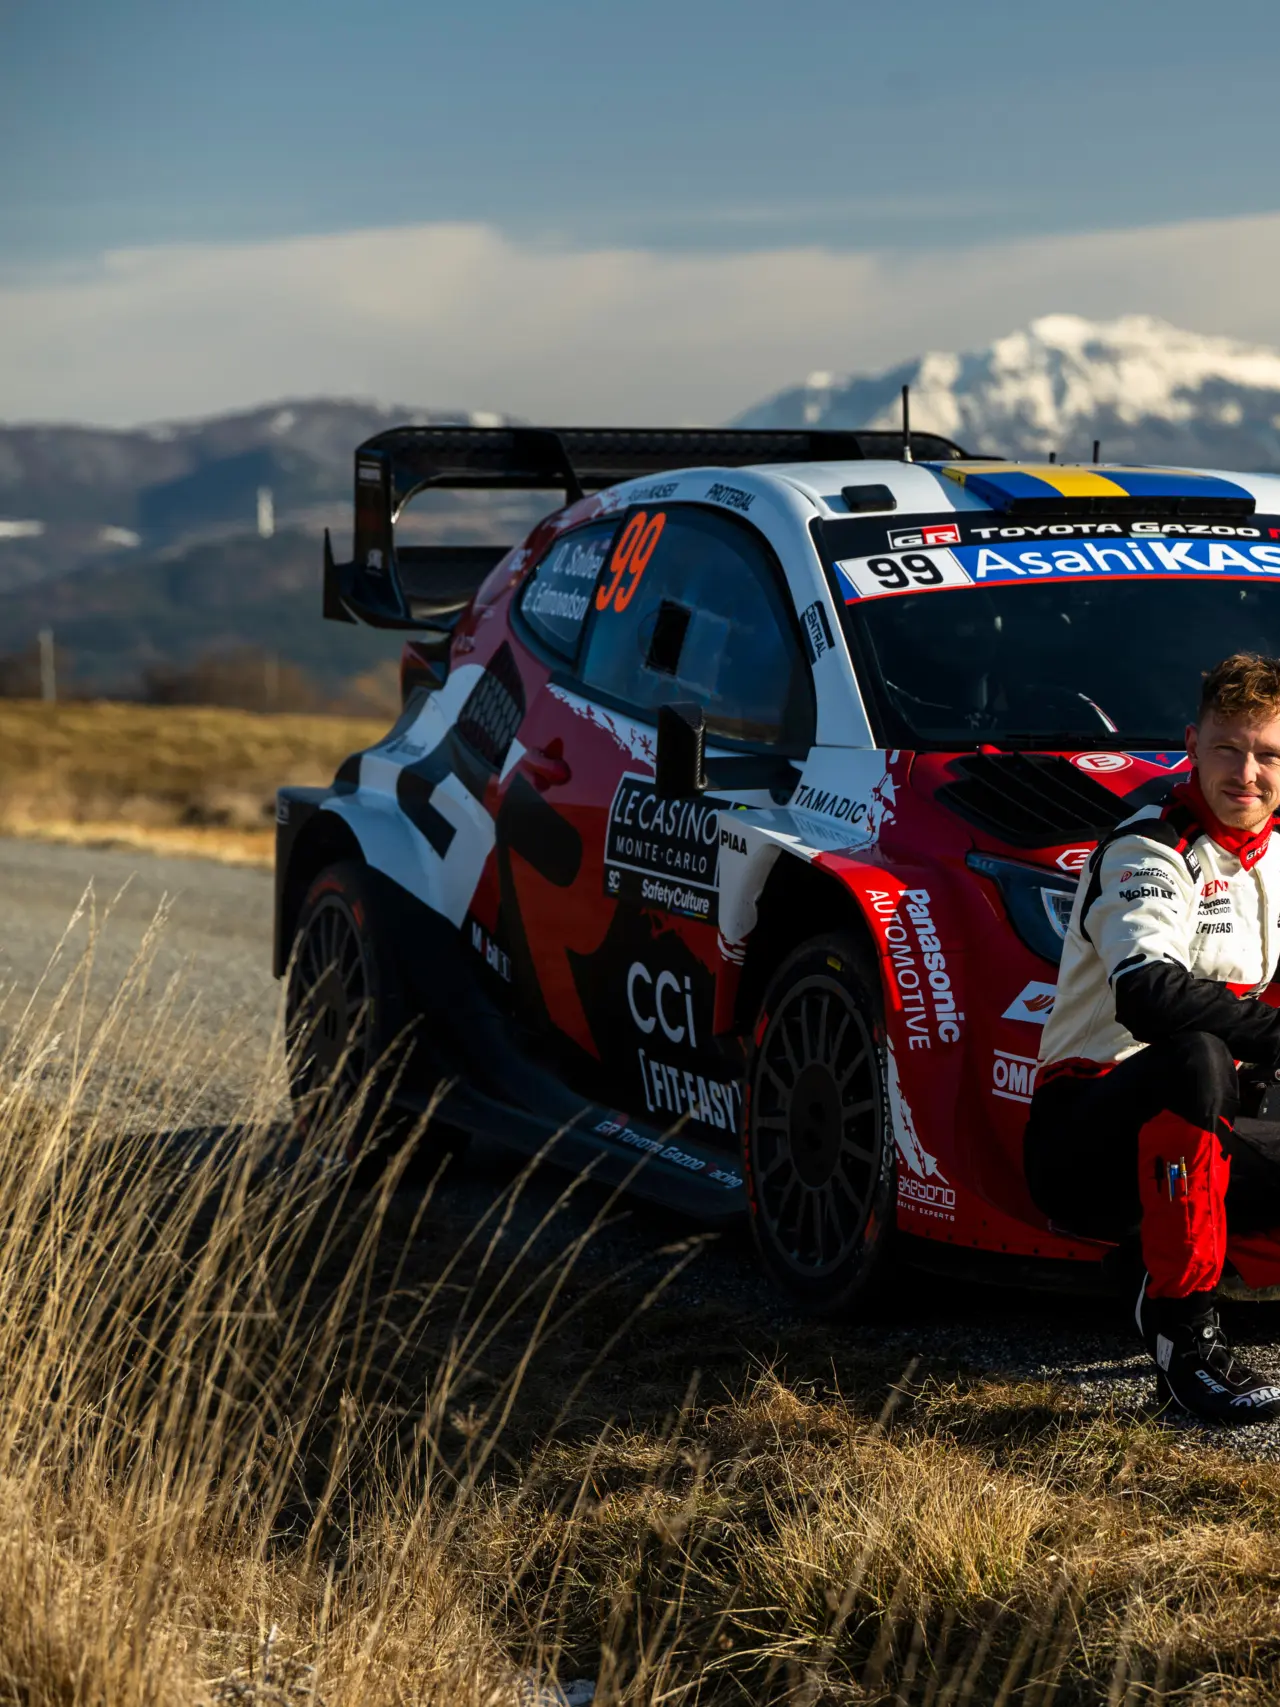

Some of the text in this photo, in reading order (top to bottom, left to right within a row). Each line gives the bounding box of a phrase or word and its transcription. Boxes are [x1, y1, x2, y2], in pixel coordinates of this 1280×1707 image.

[705, 483, 755, 511] PROTERIAL
[892, 529, 958, 547] GR
[971, 523, 1122, 540] TOYOTA
[1131, 522, 1260, 537] GAZOO
[595, 512, 666, 613] 99
[867, 554, 943, 589] 99
[805, 603, 827, 659] CENTRAL
[794, 785, 867, 825] TAMADIC
[721, 830, 747, 855] PIAA
[607, 869, 621, 890] SC
[641, 878, 710, 914] SafetyCulture
[1119, 887, 1158, 902] Mobil
[865, 889, 932, 1051] AUTOMOTIVE
[898, 888, 966, 1043] Panasonic
[626, 960, 697, 1049] CCi
[617, 1128, 665, 1155] TOYOTA
[659, 1145, 707, 1172] GAZOO
[919, 1207, 955, 1222] EXPERTS
[1194, 1369, 1227, 1394] one
